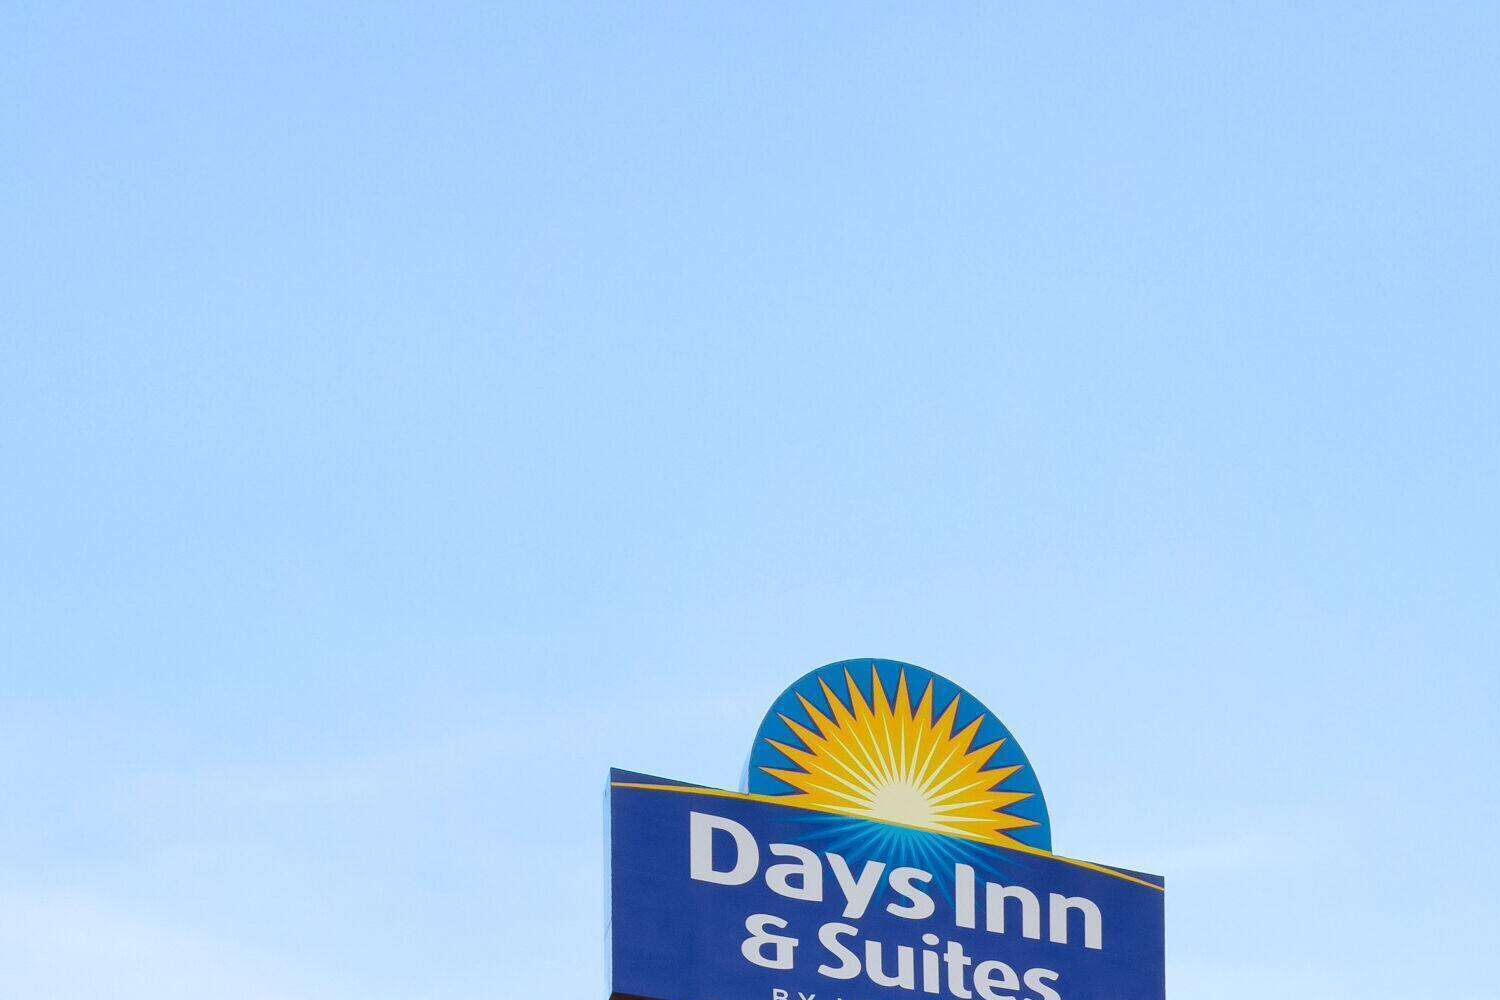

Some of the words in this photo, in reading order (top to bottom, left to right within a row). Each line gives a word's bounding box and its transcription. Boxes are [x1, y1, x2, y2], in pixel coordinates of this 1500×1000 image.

[690, 811, 935, 920] Days
[955, 862, 1102, 950] Inn
[741, 913, 799, 970] &
